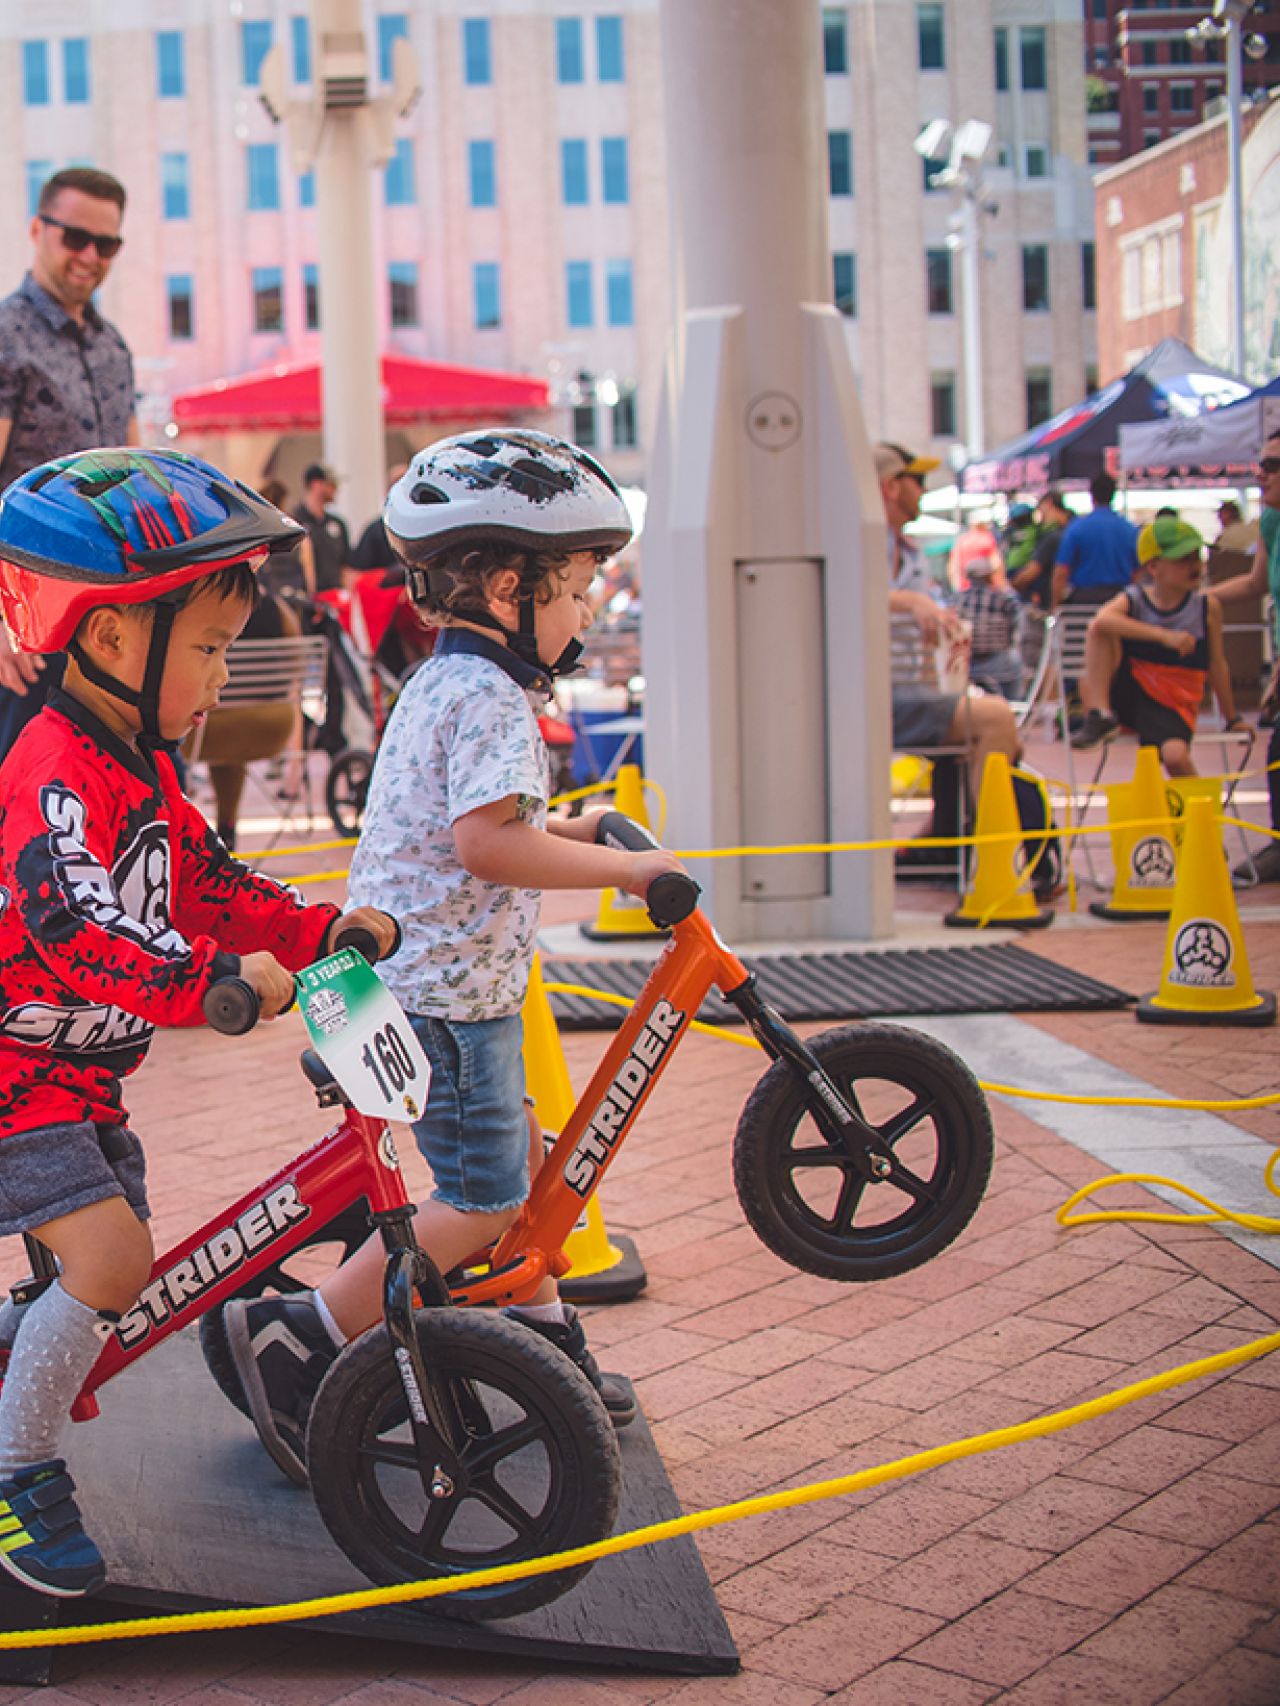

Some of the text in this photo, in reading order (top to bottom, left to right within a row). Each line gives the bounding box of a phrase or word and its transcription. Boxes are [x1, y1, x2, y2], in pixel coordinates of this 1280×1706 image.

[361, 1021, 418, 1104] 160
[562, 999, 686, 1198] STRIDER
[119, 1183, 311, 1349] STRIDER
